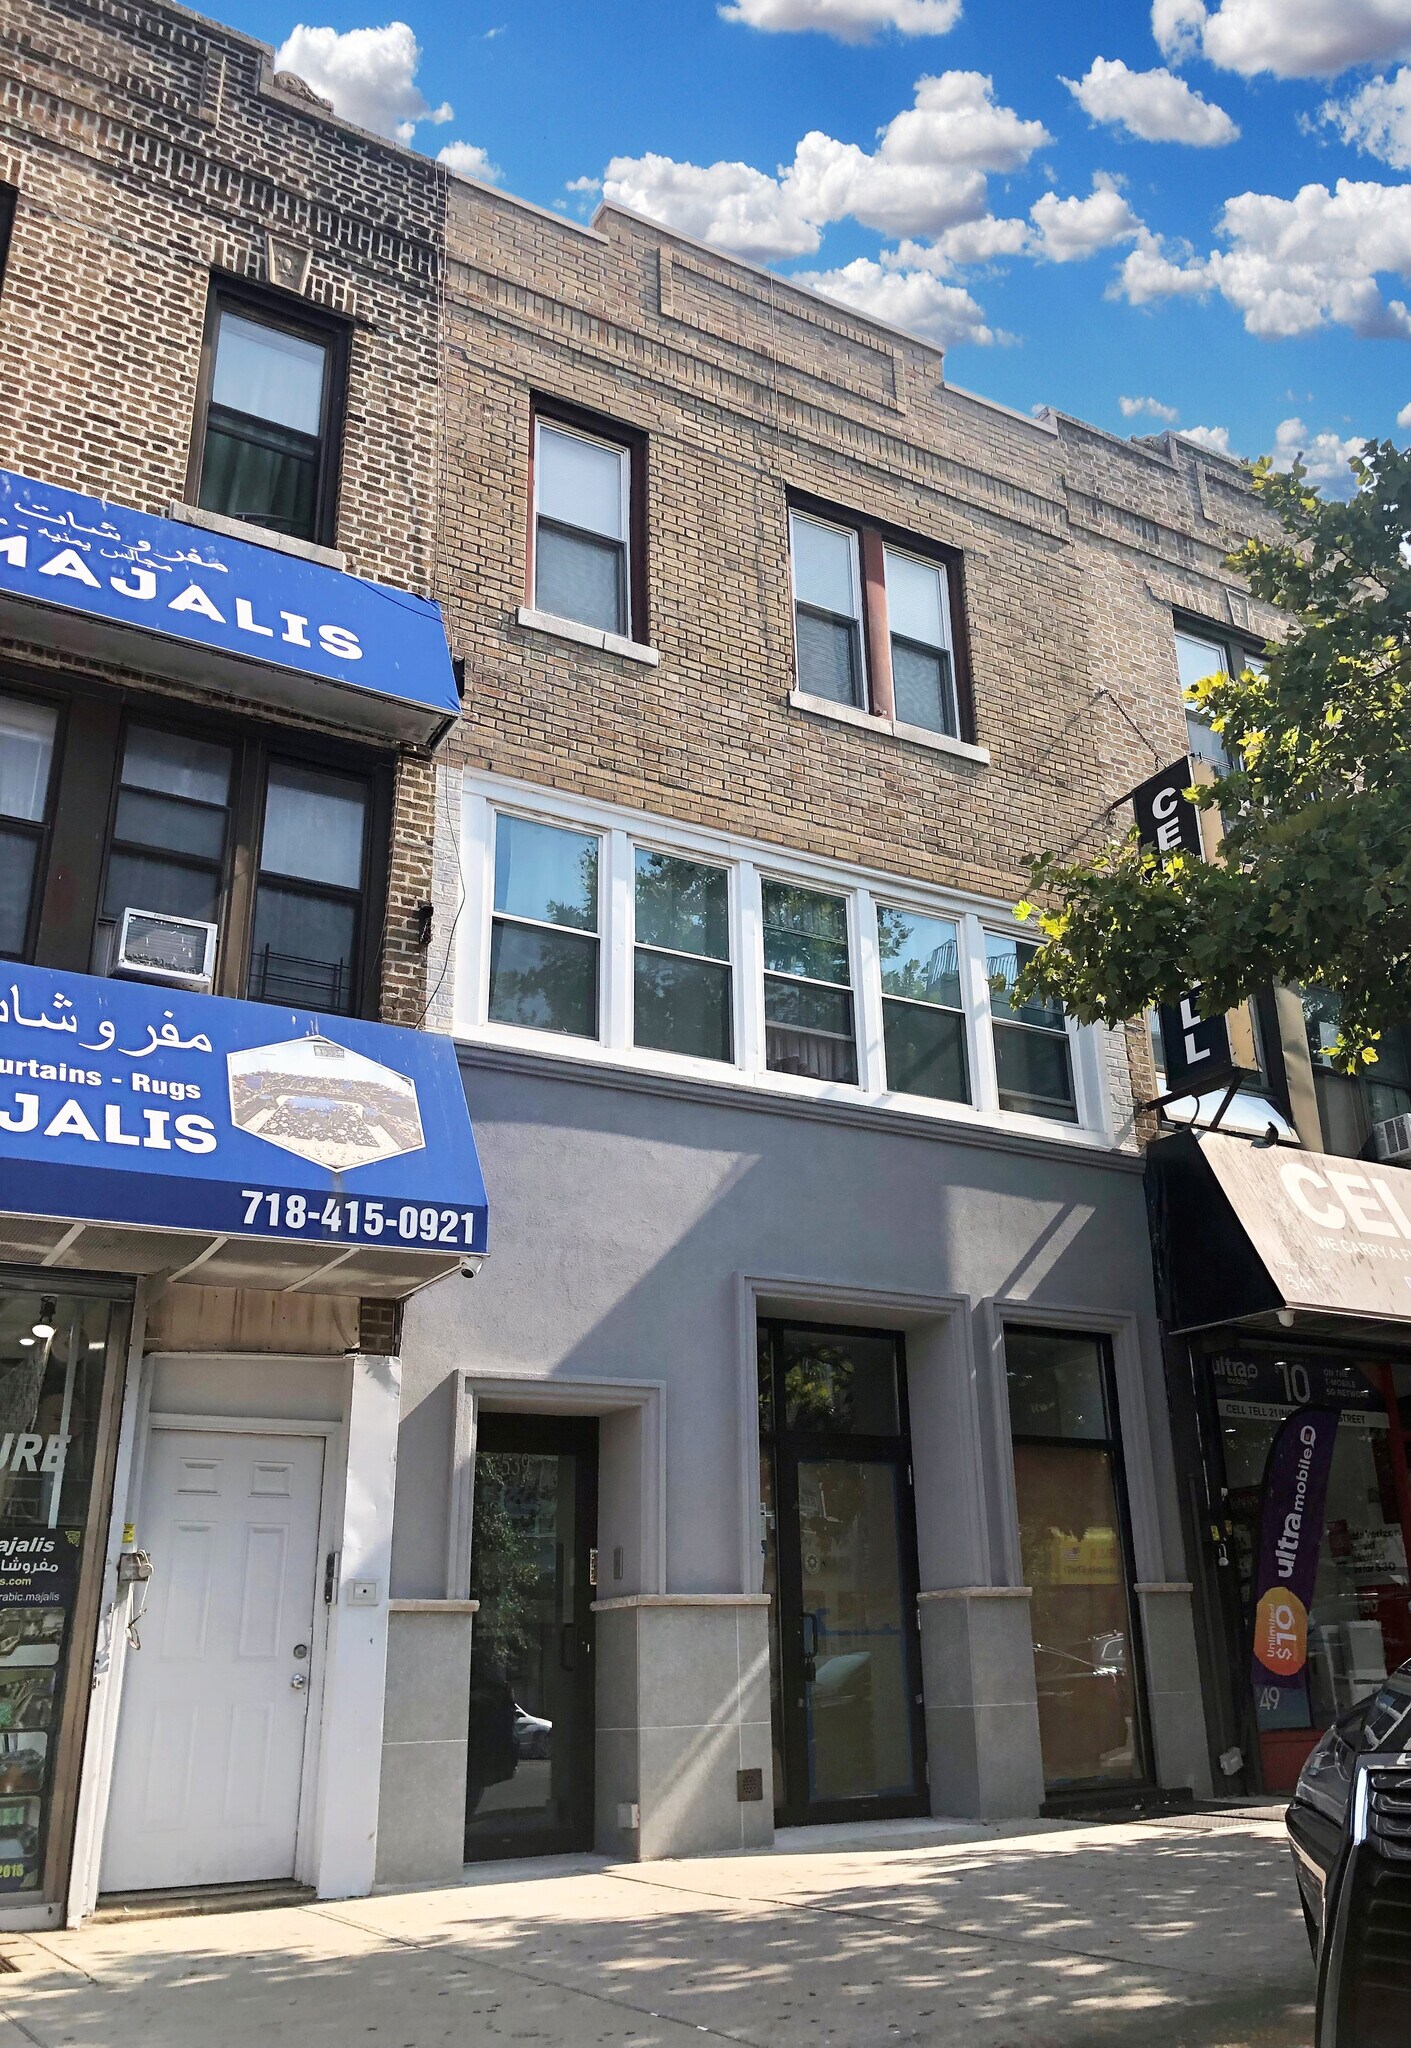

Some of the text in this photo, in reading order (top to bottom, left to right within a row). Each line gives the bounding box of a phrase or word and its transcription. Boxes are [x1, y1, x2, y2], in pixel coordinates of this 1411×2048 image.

[0, 984, 213, 1057] مفروشا
[132, 1072, 201, 1101] Rugs
[0, 1092, 217, 1155] JALIS
[241, 1189, 474, 1245] 718-415-0921
[1314, 1236, 1340, 1253] WE
[1340, 1240, 1387, 1260] CARRY
[1388, 1248, 1402, 1262] A
[1211, 1355, 1248, 1379] ultra
[1226, 1404, 1247, 1415] CELL
[1249, 1406, 1267, 1417] TELL
[1266, 1602, 1276, 1659] Unlimited
